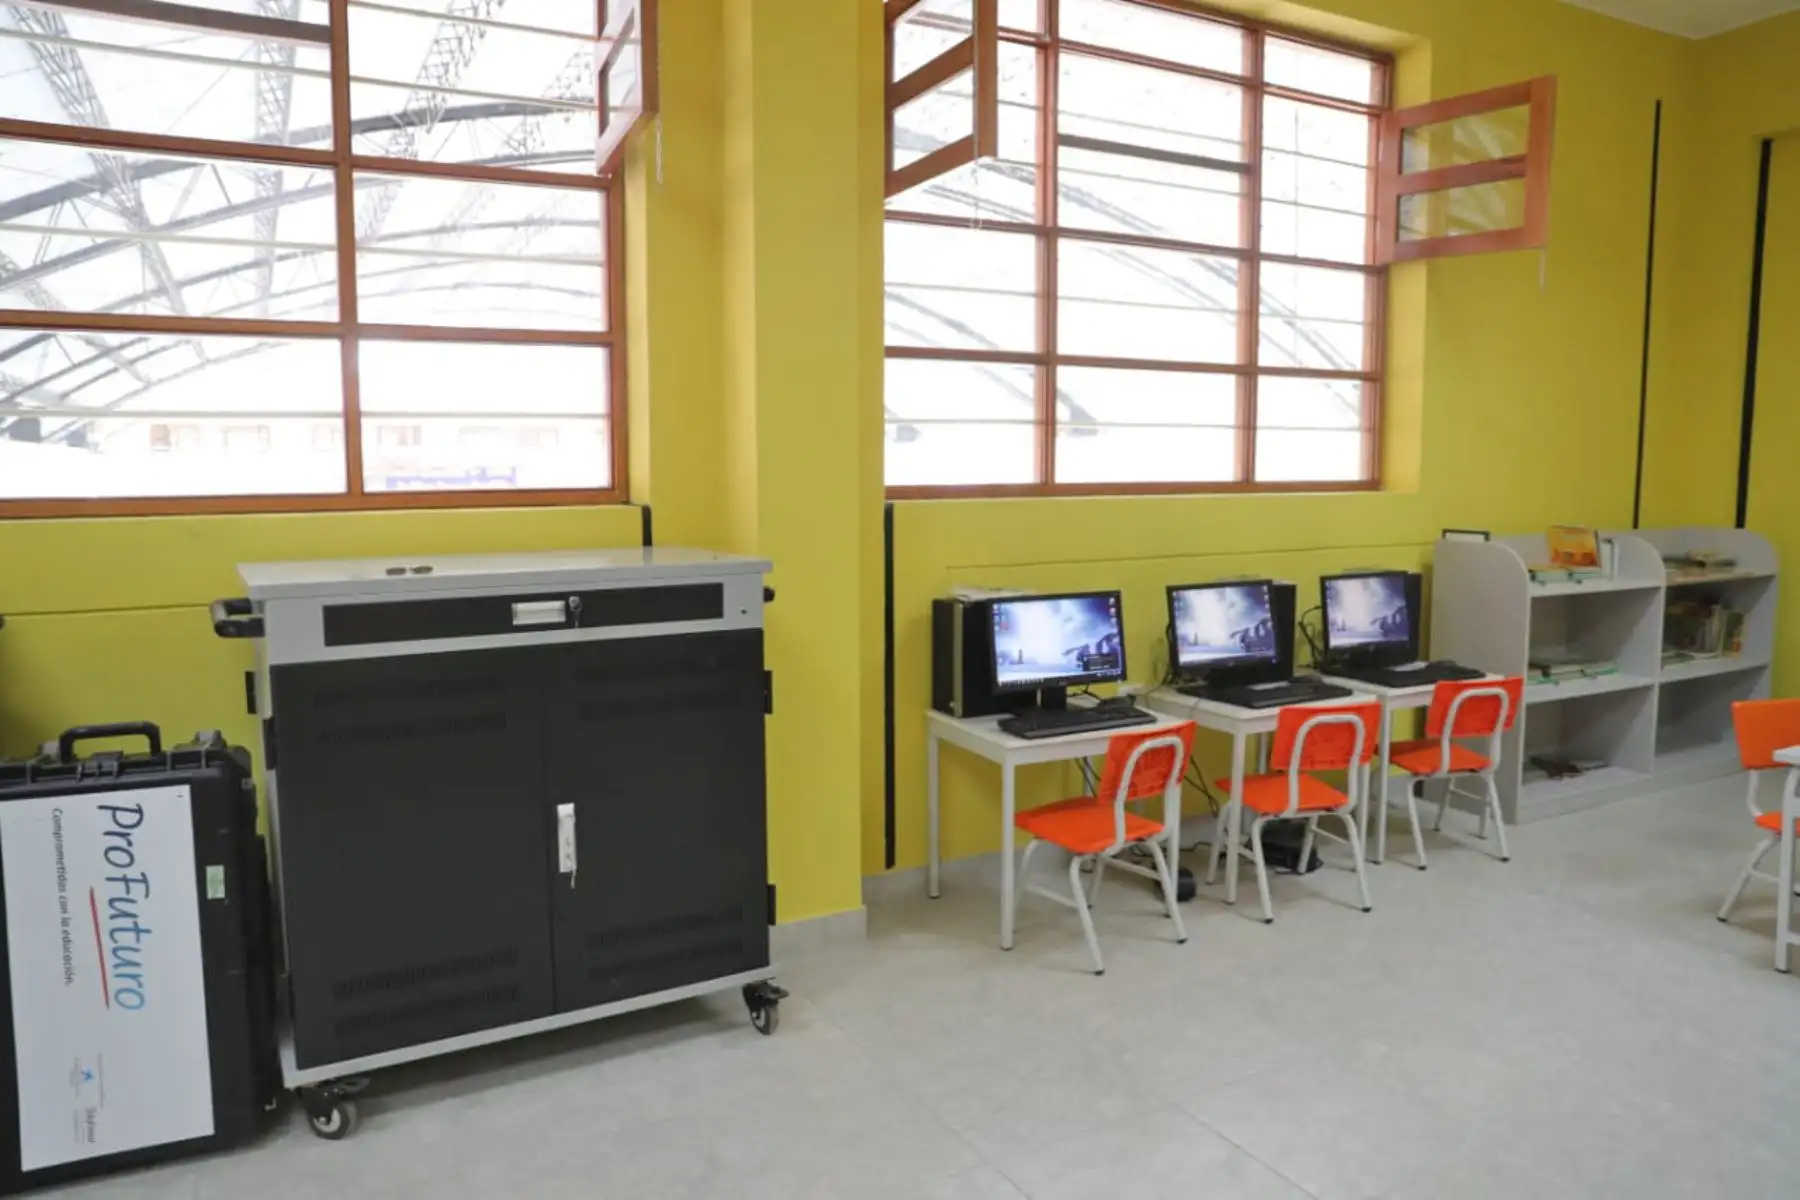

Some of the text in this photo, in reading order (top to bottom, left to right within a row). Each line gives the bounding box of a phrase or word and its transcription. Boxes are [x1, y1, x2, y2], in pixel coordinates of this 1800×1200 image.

[52, 807, 68, 893] Comprometidos
[58, 895, 68, 914] con
[61, 917, 72, 928] la
[97, 802, 153, 1011] ProFuturo
